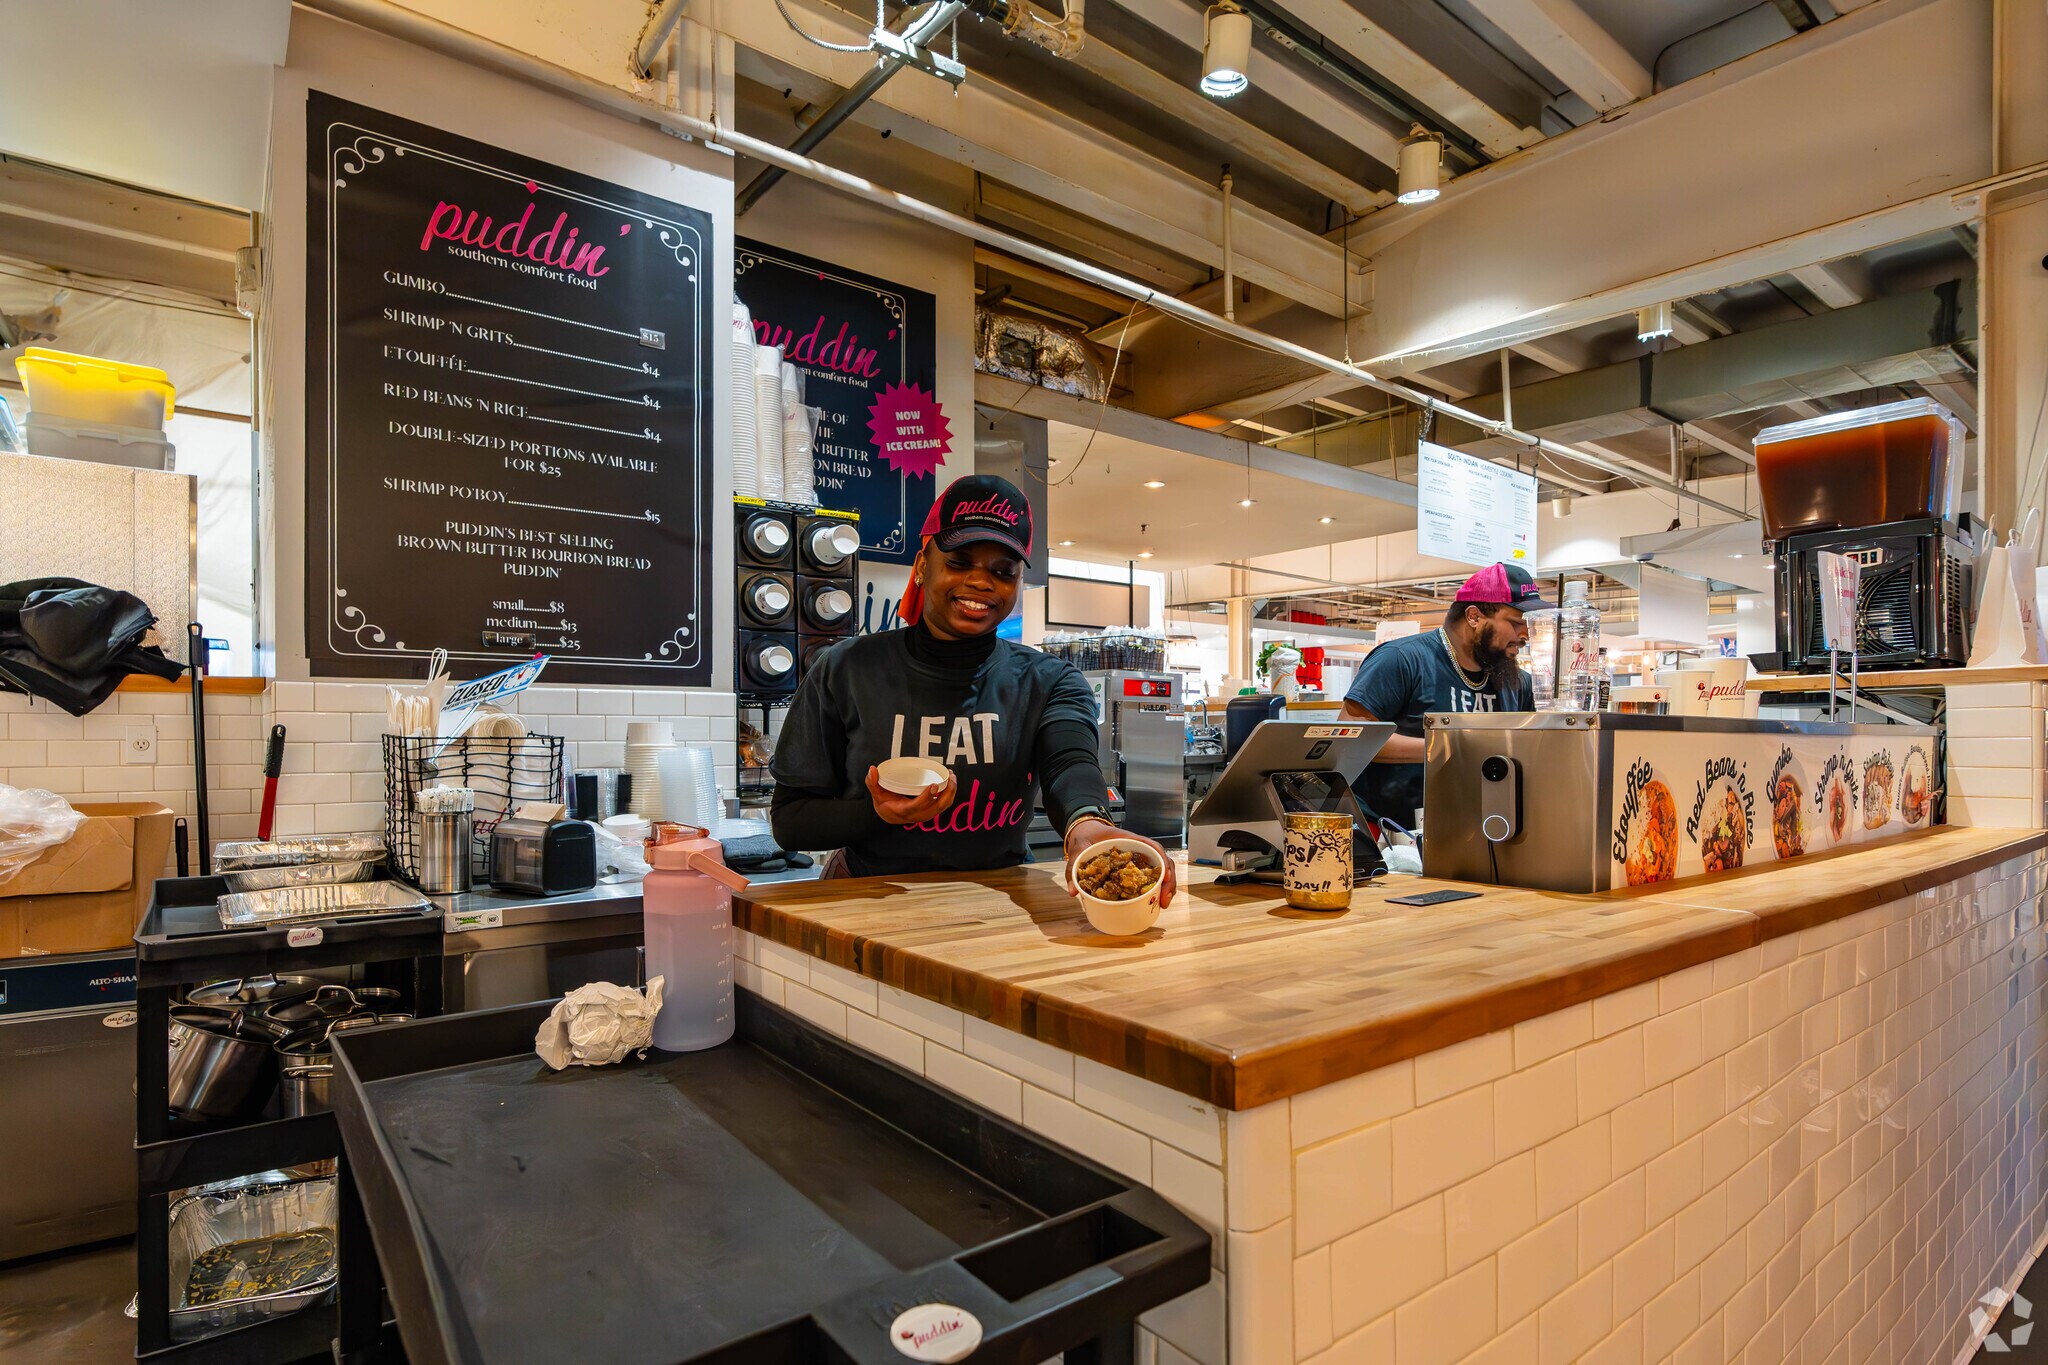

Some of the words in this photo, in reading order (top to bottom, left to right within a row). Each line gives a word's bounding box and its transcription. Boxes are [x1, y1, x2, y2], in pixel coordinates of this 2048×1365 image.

[419, 200, 631, 277] puddin'
[447, 244, 508, 268] southern
[511, 259, 564, 283] comfort
[567, 272, 597, 291] food
[383, 270, 446, 295] GUMBO
[641, 330, 660, 343] $15
[383, 307, 445, 331] SHRIMP
[466, 325, 514, 346] GRITS
[641, 361, 661, 379] $14
[812, 369, 847, 385] comfort
[848, 376, 869, 389] food
[383, 382, 419, 400] RED
[423, 388, 473, 410] BEANS
[493, 401, 529, 420] RICE
[643, 427, 662, 444] $14
[642, 393, 661, 410] $14
[895, 410, 921, 421] NOW
[896, 425, 924, 435] WITH
[388, 420, 506, 450] DOUBLE-SIZED
[509, 439, 586, 463] PORTIONS
[588, 452, 659, 474] AVAILABLE
[822, 443, 869, 463] BUTTER
[886, 439, 904, 452] ICE
[903, 438, 942, 451] CREAM!
[503, 456, 536, 472] FOR
[539, 460, 562, 478] $25
[833, 461, 872, 478] BREAD
[813, 475, 846, 490] DDIN'
[383, 476, 445, 496] SHRIMP
[449, 483, 509, 504] PO'BOY
[644, 509, 661, 525] $15
[952, 492, 1025, 527] puddin'
[445, 519, 516, 541] PUDDIN'S
[518, 528, 556, 544] BEST
[558, 532, 614, 550] SELLING
[397, 533, 462, 553] BROWN
[465, 541, 528, 560] BUTTER
[531, 546, 603, 567] BOURBON
[605, 552, 652, 571] BREAD
[503, 561, 563, 579] PUDDIN'
[492, 598, 524, 612] small
[549, 599, 565, 614] $8
[486, 615, 538, 630] medium
[560, 618, 578, 634] $13
[495, 631, 524, 647] large
[559, 635, 581, 651] $25
[446, 673, 509, 706] CLOSED
[1450, 686, 1457, 713] I
[1459, 690, 1498, 713] EAT
[1143, 704, 1167, 712] VULCAN
[891, 714, 905, 760] I
[918, 713, 1000, 766] EAT
[1766, 743, 1793, 808] Gumbo
[1815, 754, 1838, 814] Shrimp
[1844, 758, 1859, 810] Grits
[1686, 780, 1706, 844] Red
[1705, 756, 1738, 793] Beans
[1742, 791, 1756, 849] Rice
[89, 975, 138, 986] ALTO-SHAA
